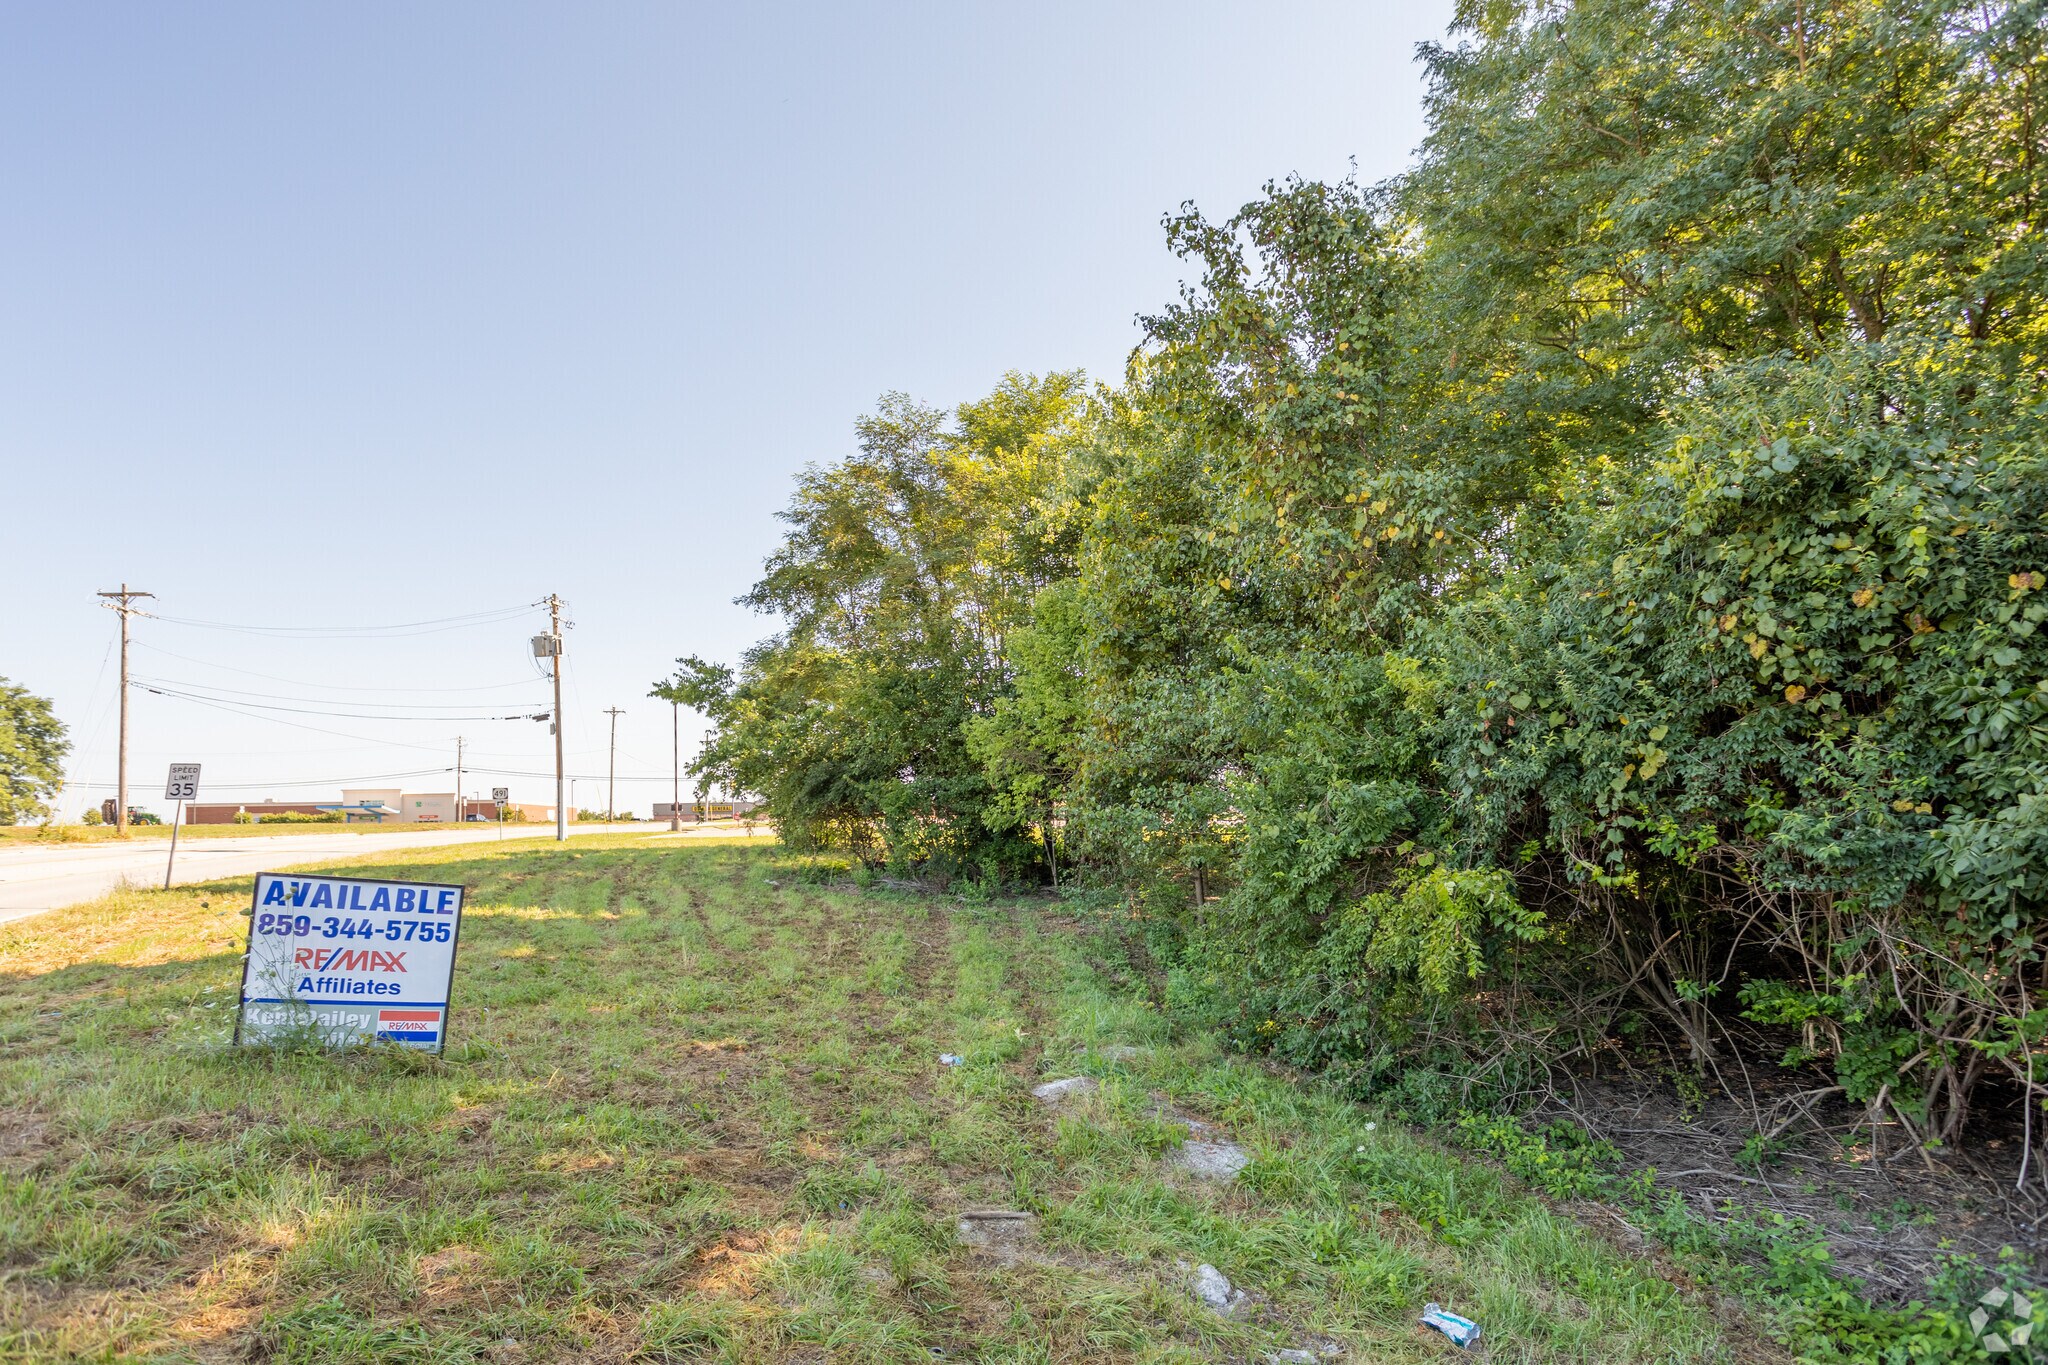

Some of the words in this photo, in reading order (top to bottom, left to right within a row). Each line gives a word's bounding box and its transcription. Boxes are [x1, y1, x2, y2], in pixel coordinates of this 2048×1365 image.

[169, 783, 194, 796] 35
[263, 880, 455, 915] AVAILABLE
[258, 913, 451, 943] 859-344-5755
[294, 947, 408, 973] RE/MAX
[297, 977, 401, 995] Affiliates
[388, 1021, 428, 1030] RE/MAX
